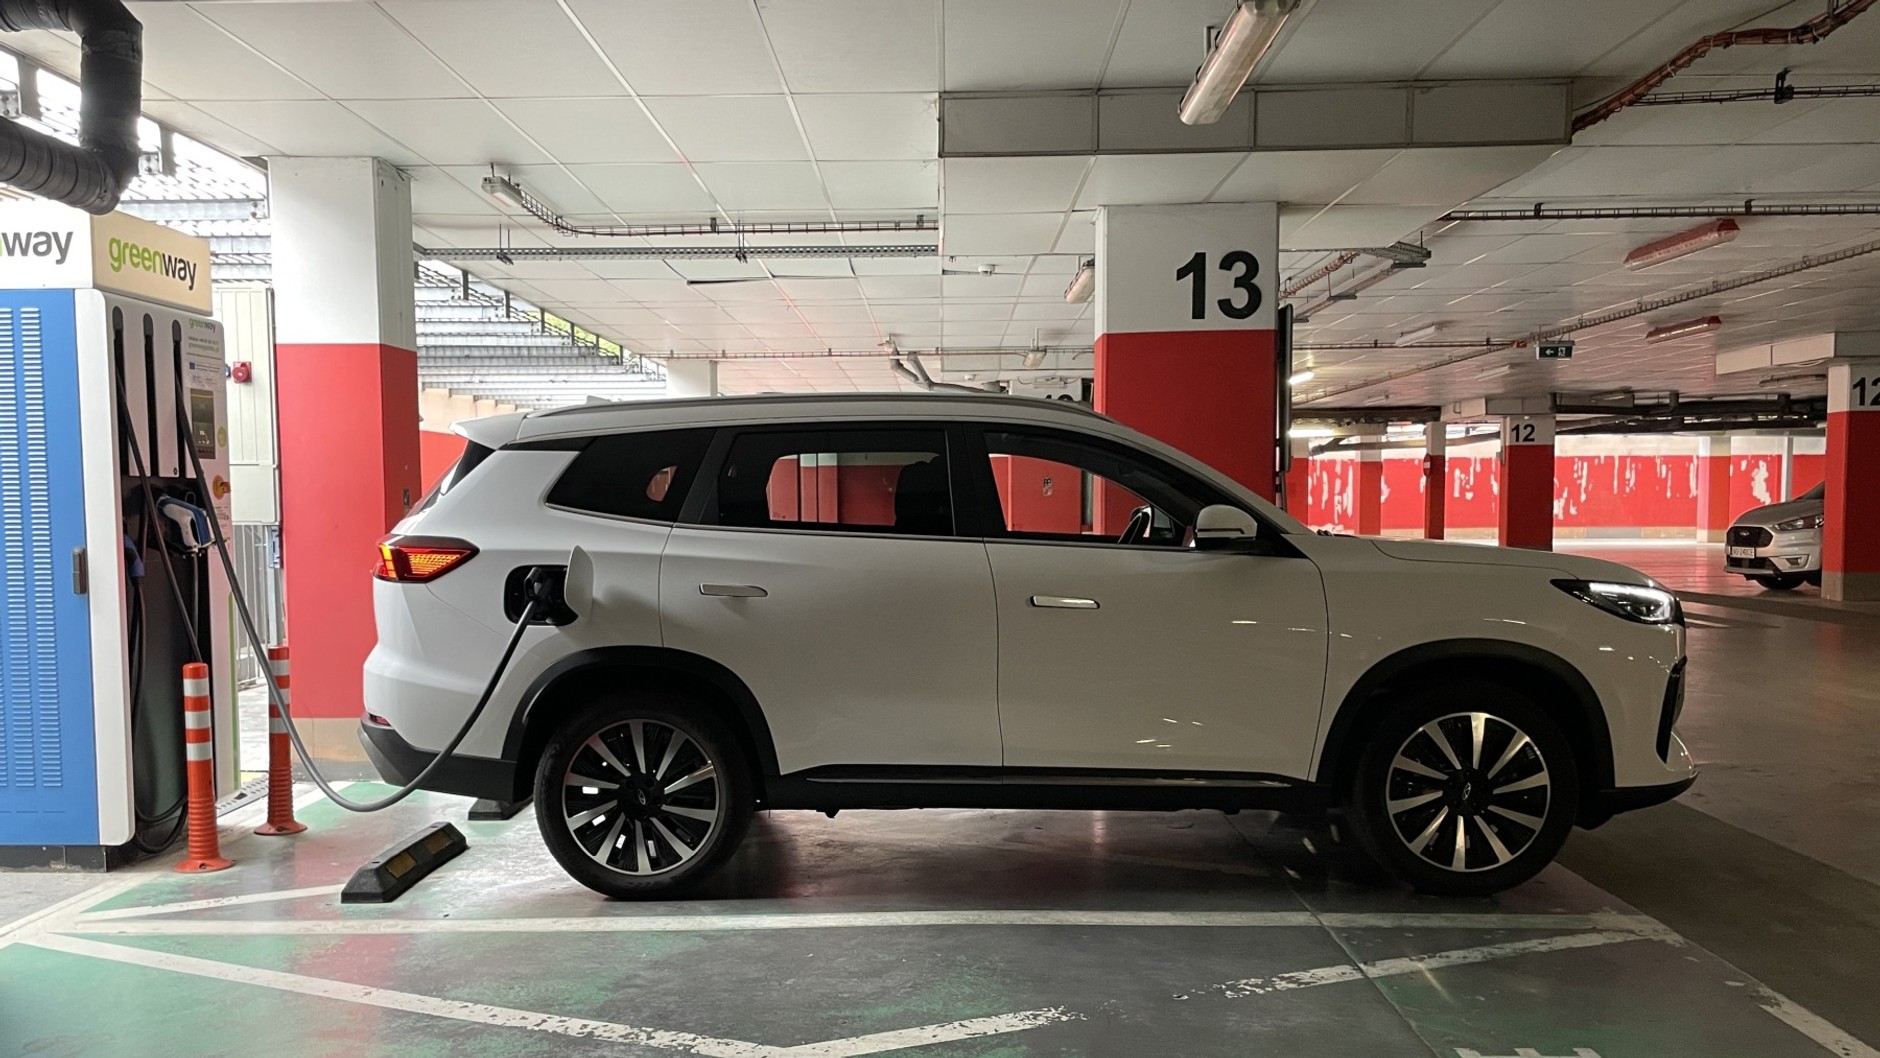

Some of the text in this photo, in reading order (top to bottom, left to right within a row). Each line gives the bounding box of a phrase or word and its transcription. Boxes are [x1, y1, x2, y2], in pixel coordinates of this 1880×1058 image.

[0, 230, 74, 265] way
[108, 237, 197, 291] greenway
[1176, 250, 1262, 320] 13
[1511, 423, 1536, 442] 12
